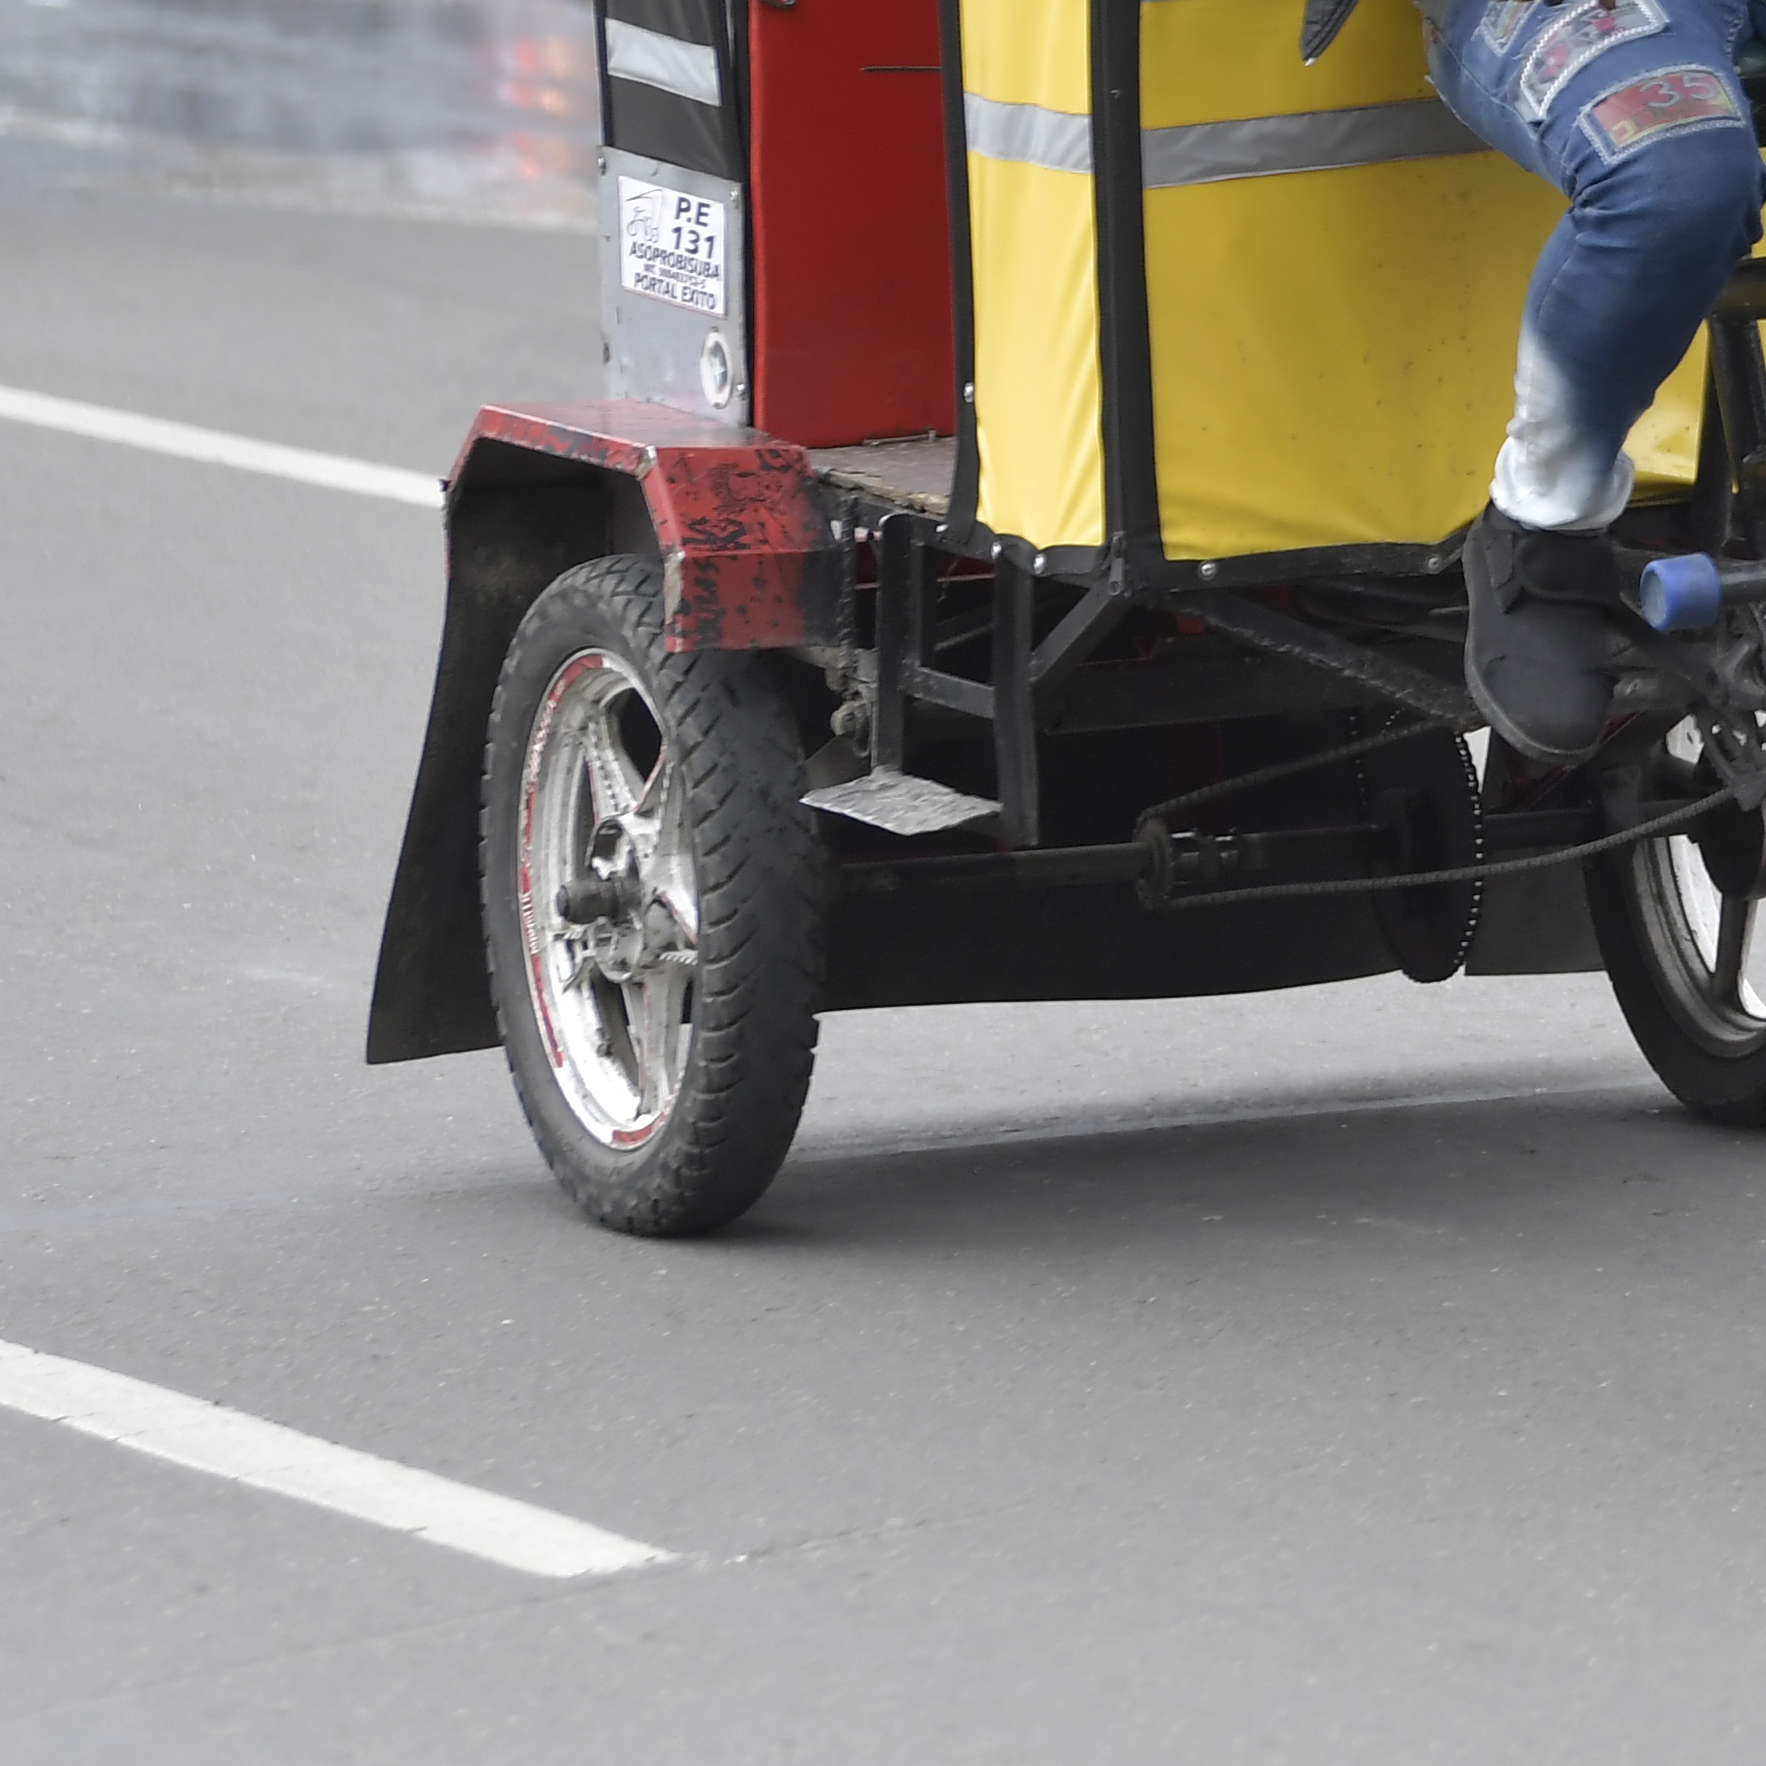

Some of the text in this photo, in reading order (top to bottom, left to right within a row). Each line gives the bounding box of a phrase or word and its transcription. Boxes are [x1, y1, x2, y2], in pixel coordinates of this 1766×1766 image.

[674, 196, 712, 228] P.E
[671, 226, 715, 260] 131
[634, 272, 678, 300] PORTAL
